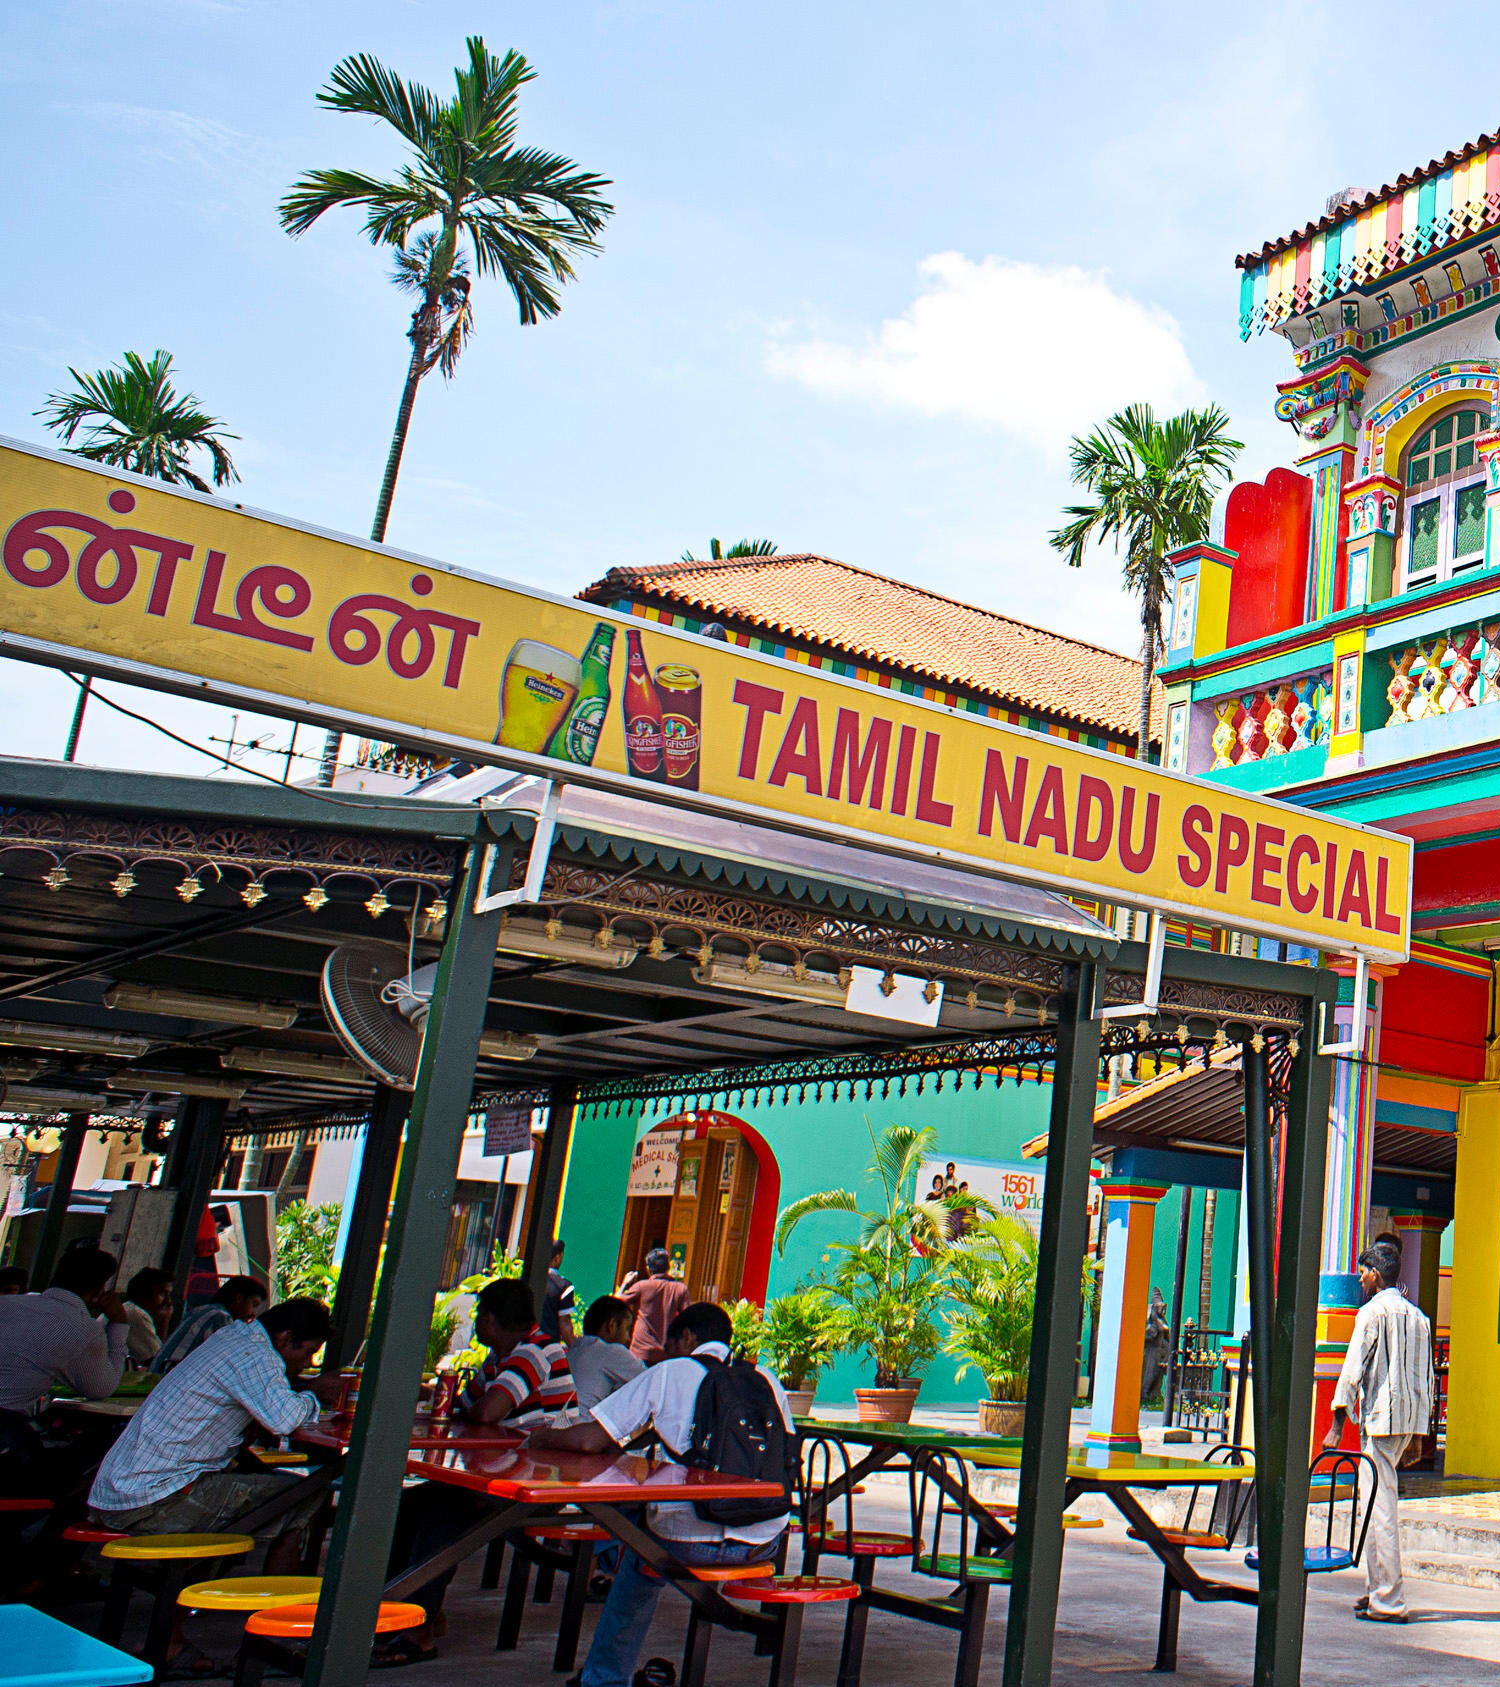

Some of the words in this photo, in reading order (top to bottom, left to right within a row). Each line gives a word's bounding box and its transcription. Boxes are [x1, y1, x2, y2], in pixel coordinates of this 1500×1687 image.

[731, 679, 955, 829] TAMIL
[976, 747, 1161, 875] NADU
[1175, 802, 1402, 936] SPECIAL
[632, 1151, 665, 1173] MEDICAL
[1001, 1173, 1035, 1194] 1561
